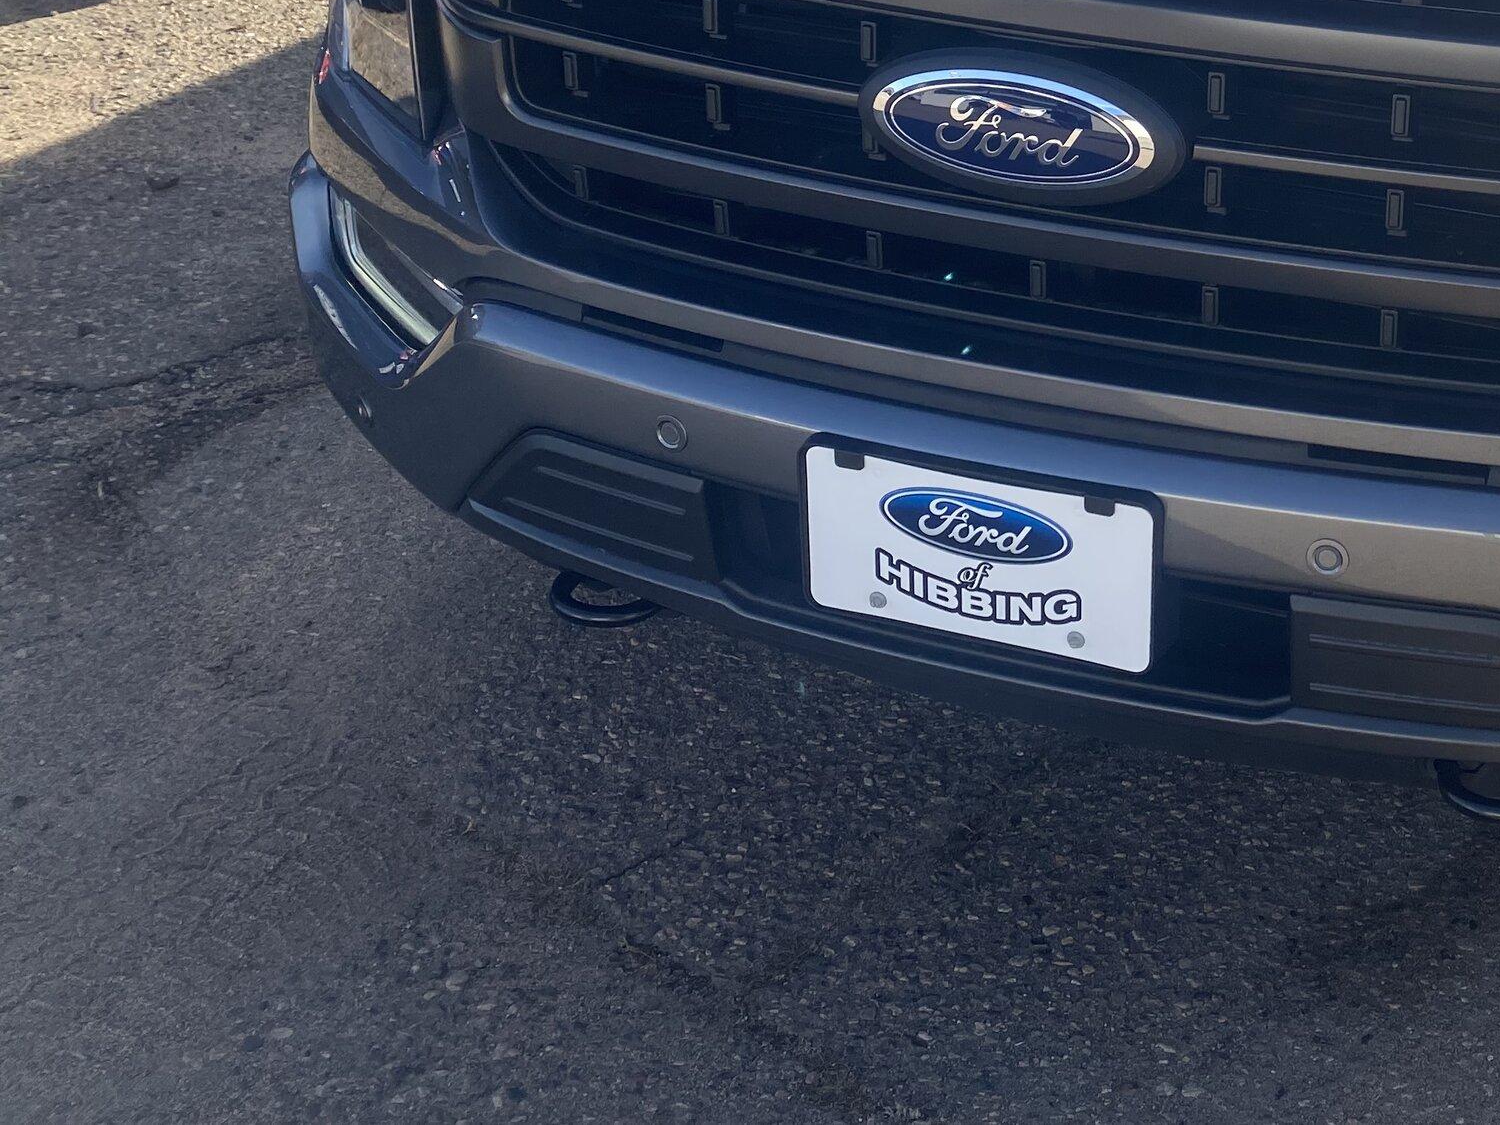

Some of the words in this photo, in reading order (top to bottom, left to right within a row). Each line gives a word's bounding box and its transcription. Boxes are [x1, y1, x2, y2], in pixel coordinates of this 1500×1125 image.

[935, 94, 1084, 168] Ford
[918, 498, 1032, 556] Ford
[874, 546, 1083, 626] HIBBING
[957, 562, 993, 589] of
